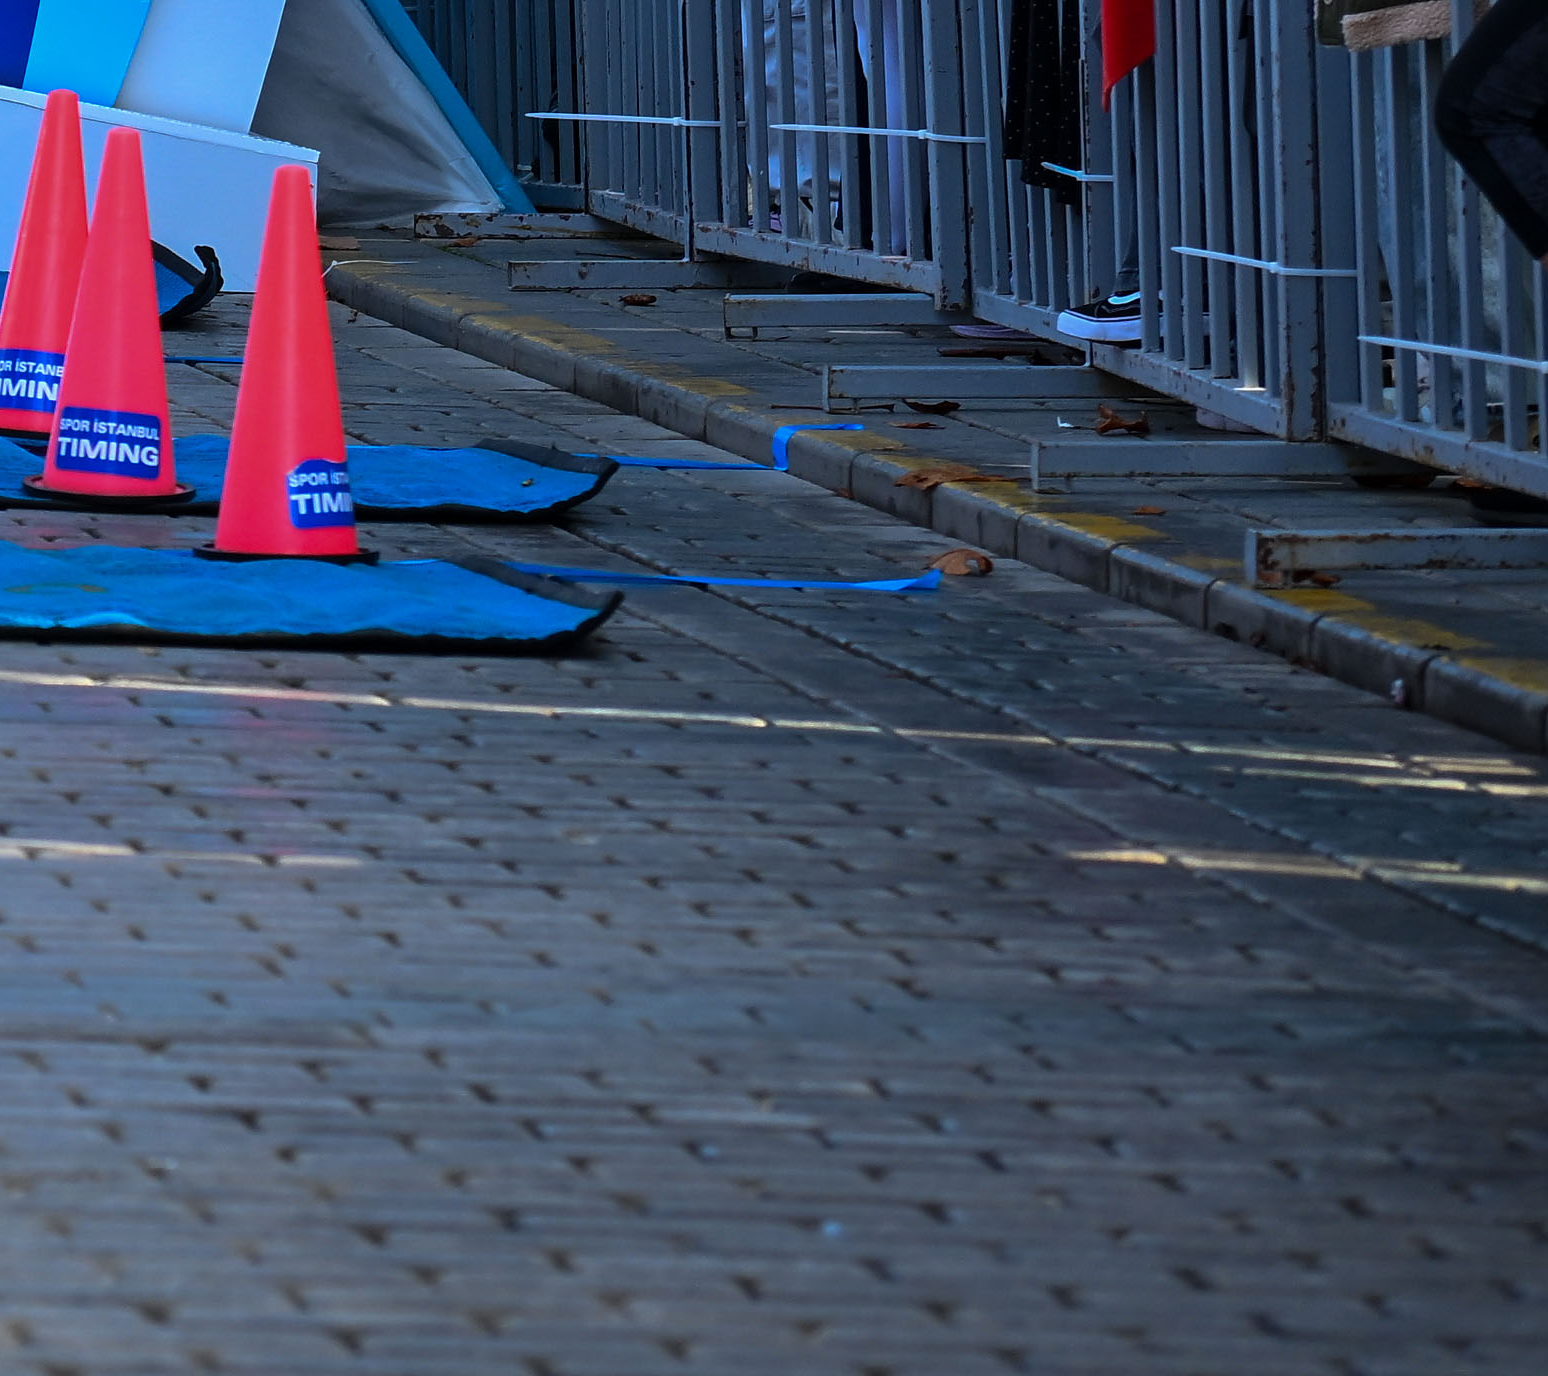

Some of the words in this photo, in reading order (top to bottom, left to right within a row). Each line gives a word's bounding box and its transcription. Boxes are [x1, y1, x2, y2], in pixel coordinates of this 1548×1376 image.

[60, 418, 90, 432] SPOR
[94, 419, 160, 441] İSTANBUL
[58, 437, 158, 466] TIMING
